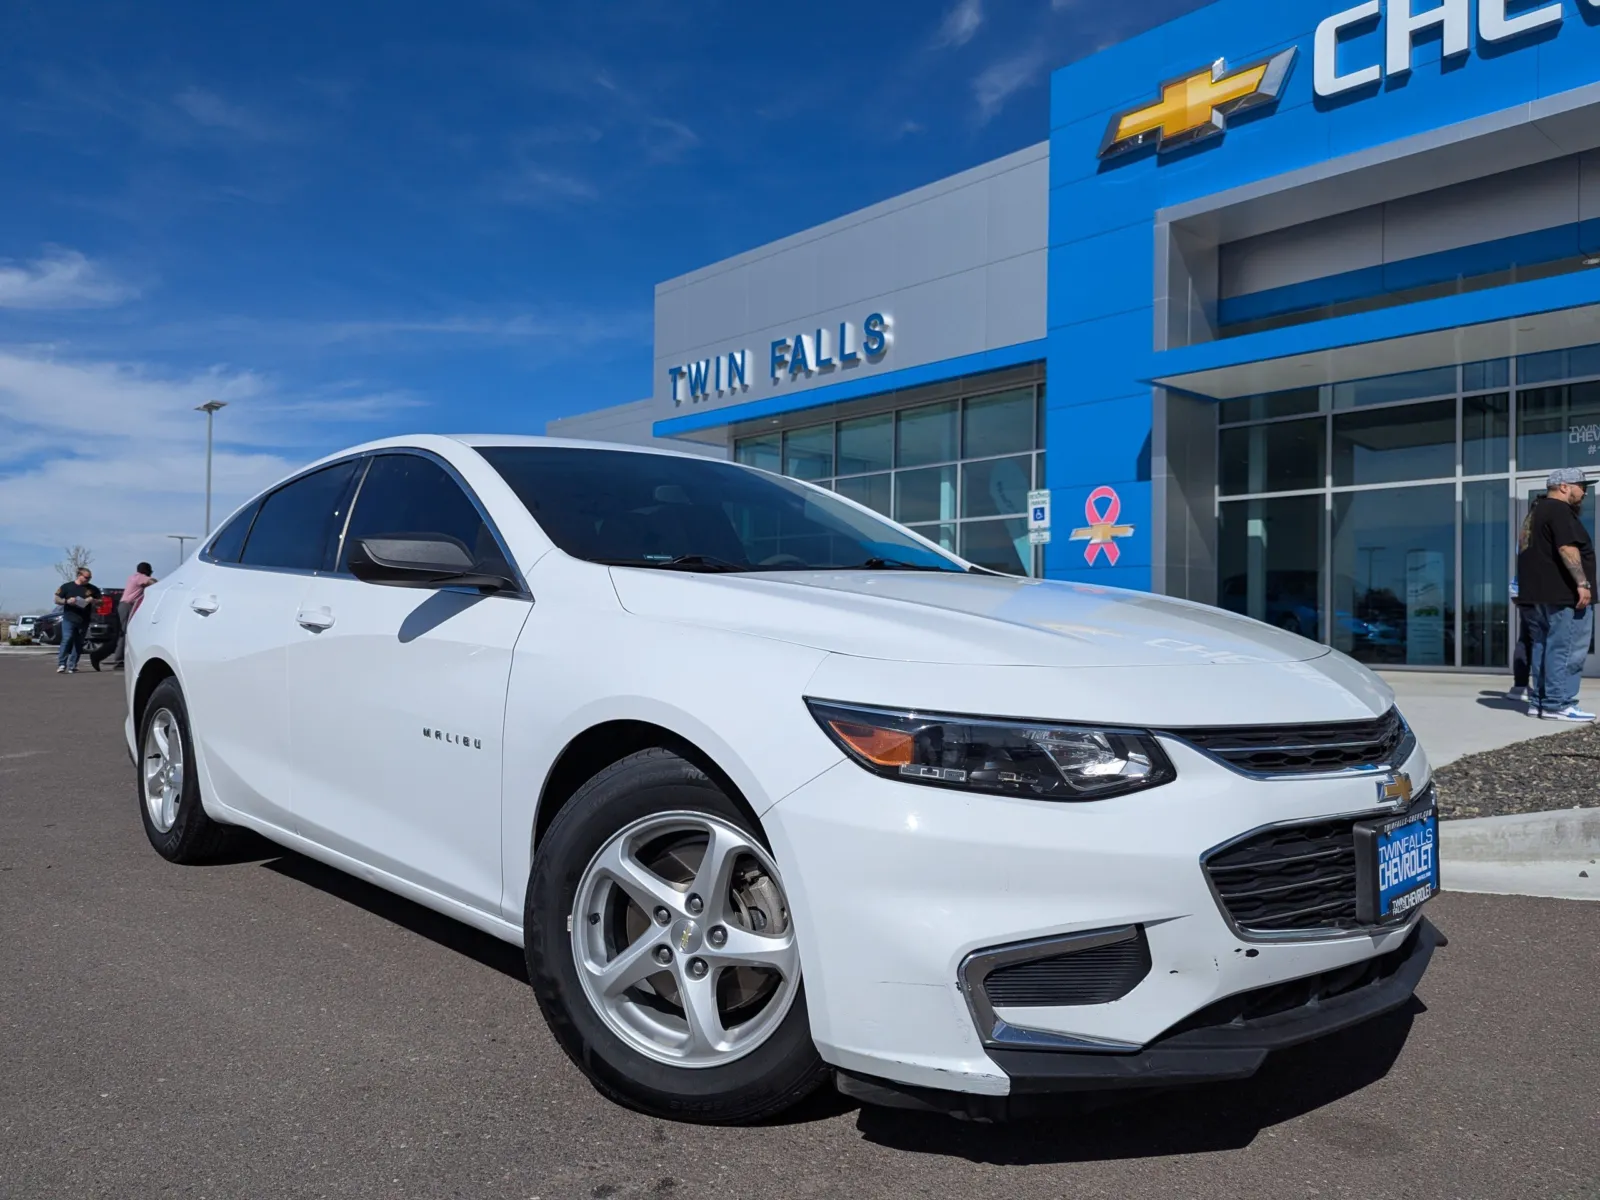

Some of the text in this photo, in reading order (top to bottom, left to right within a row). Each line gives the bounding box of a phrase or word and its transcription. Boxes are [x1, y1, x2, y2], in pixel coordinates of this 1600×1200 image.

[669, 312, 889, 402] TWIN FALLS
[423, 728, 481, 749] MALIBU
[1379, 843, 1433, 891] CHEVROLET
